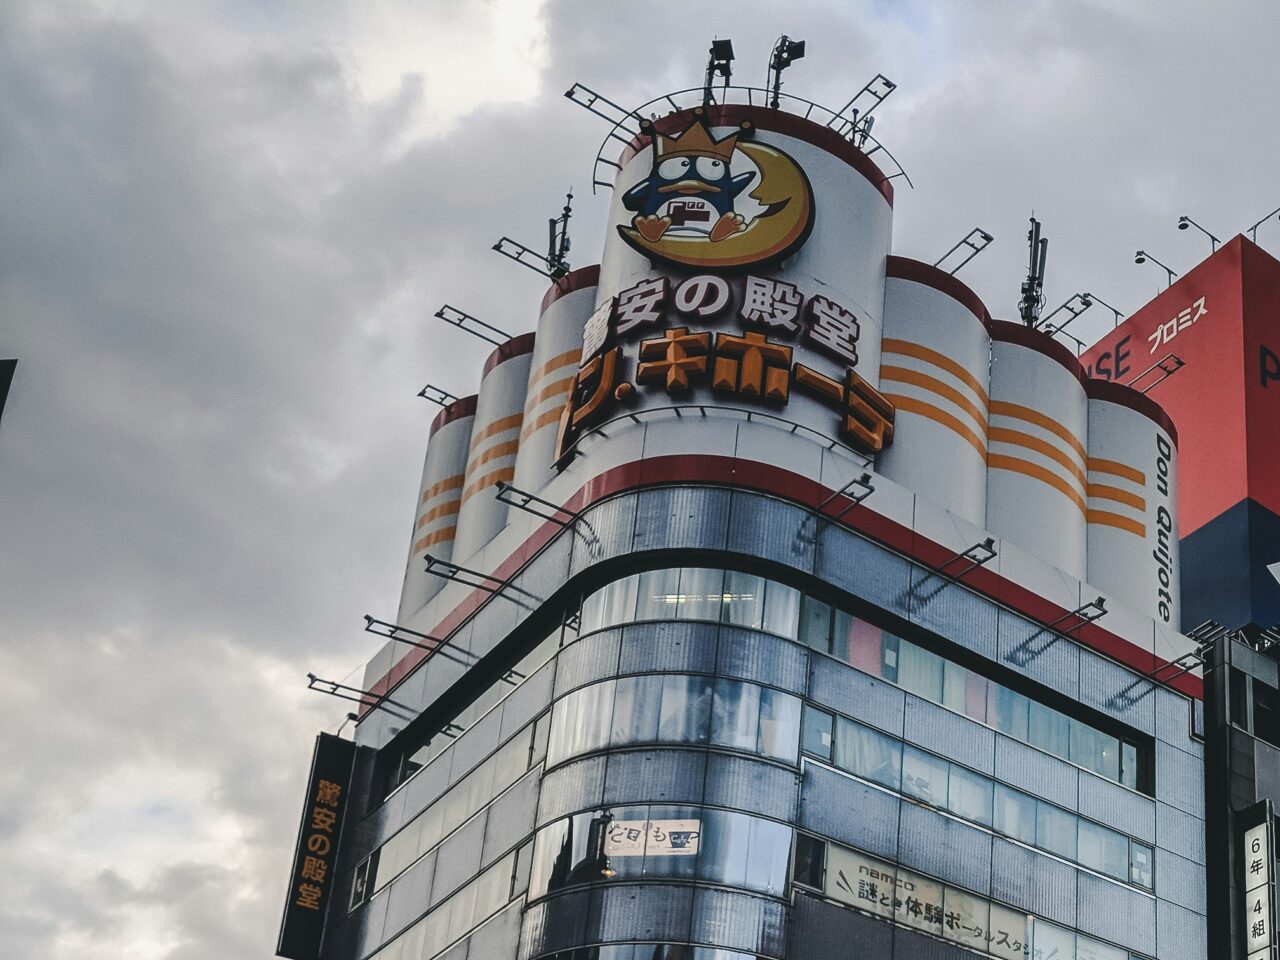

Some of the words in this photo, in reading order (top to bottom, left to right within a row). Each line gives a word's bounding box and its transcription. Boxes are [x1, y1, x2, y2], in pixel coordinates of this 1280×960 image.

[1148, 296, 1208, 355] プロミス
[1157, 433, 1172, 497] Don
